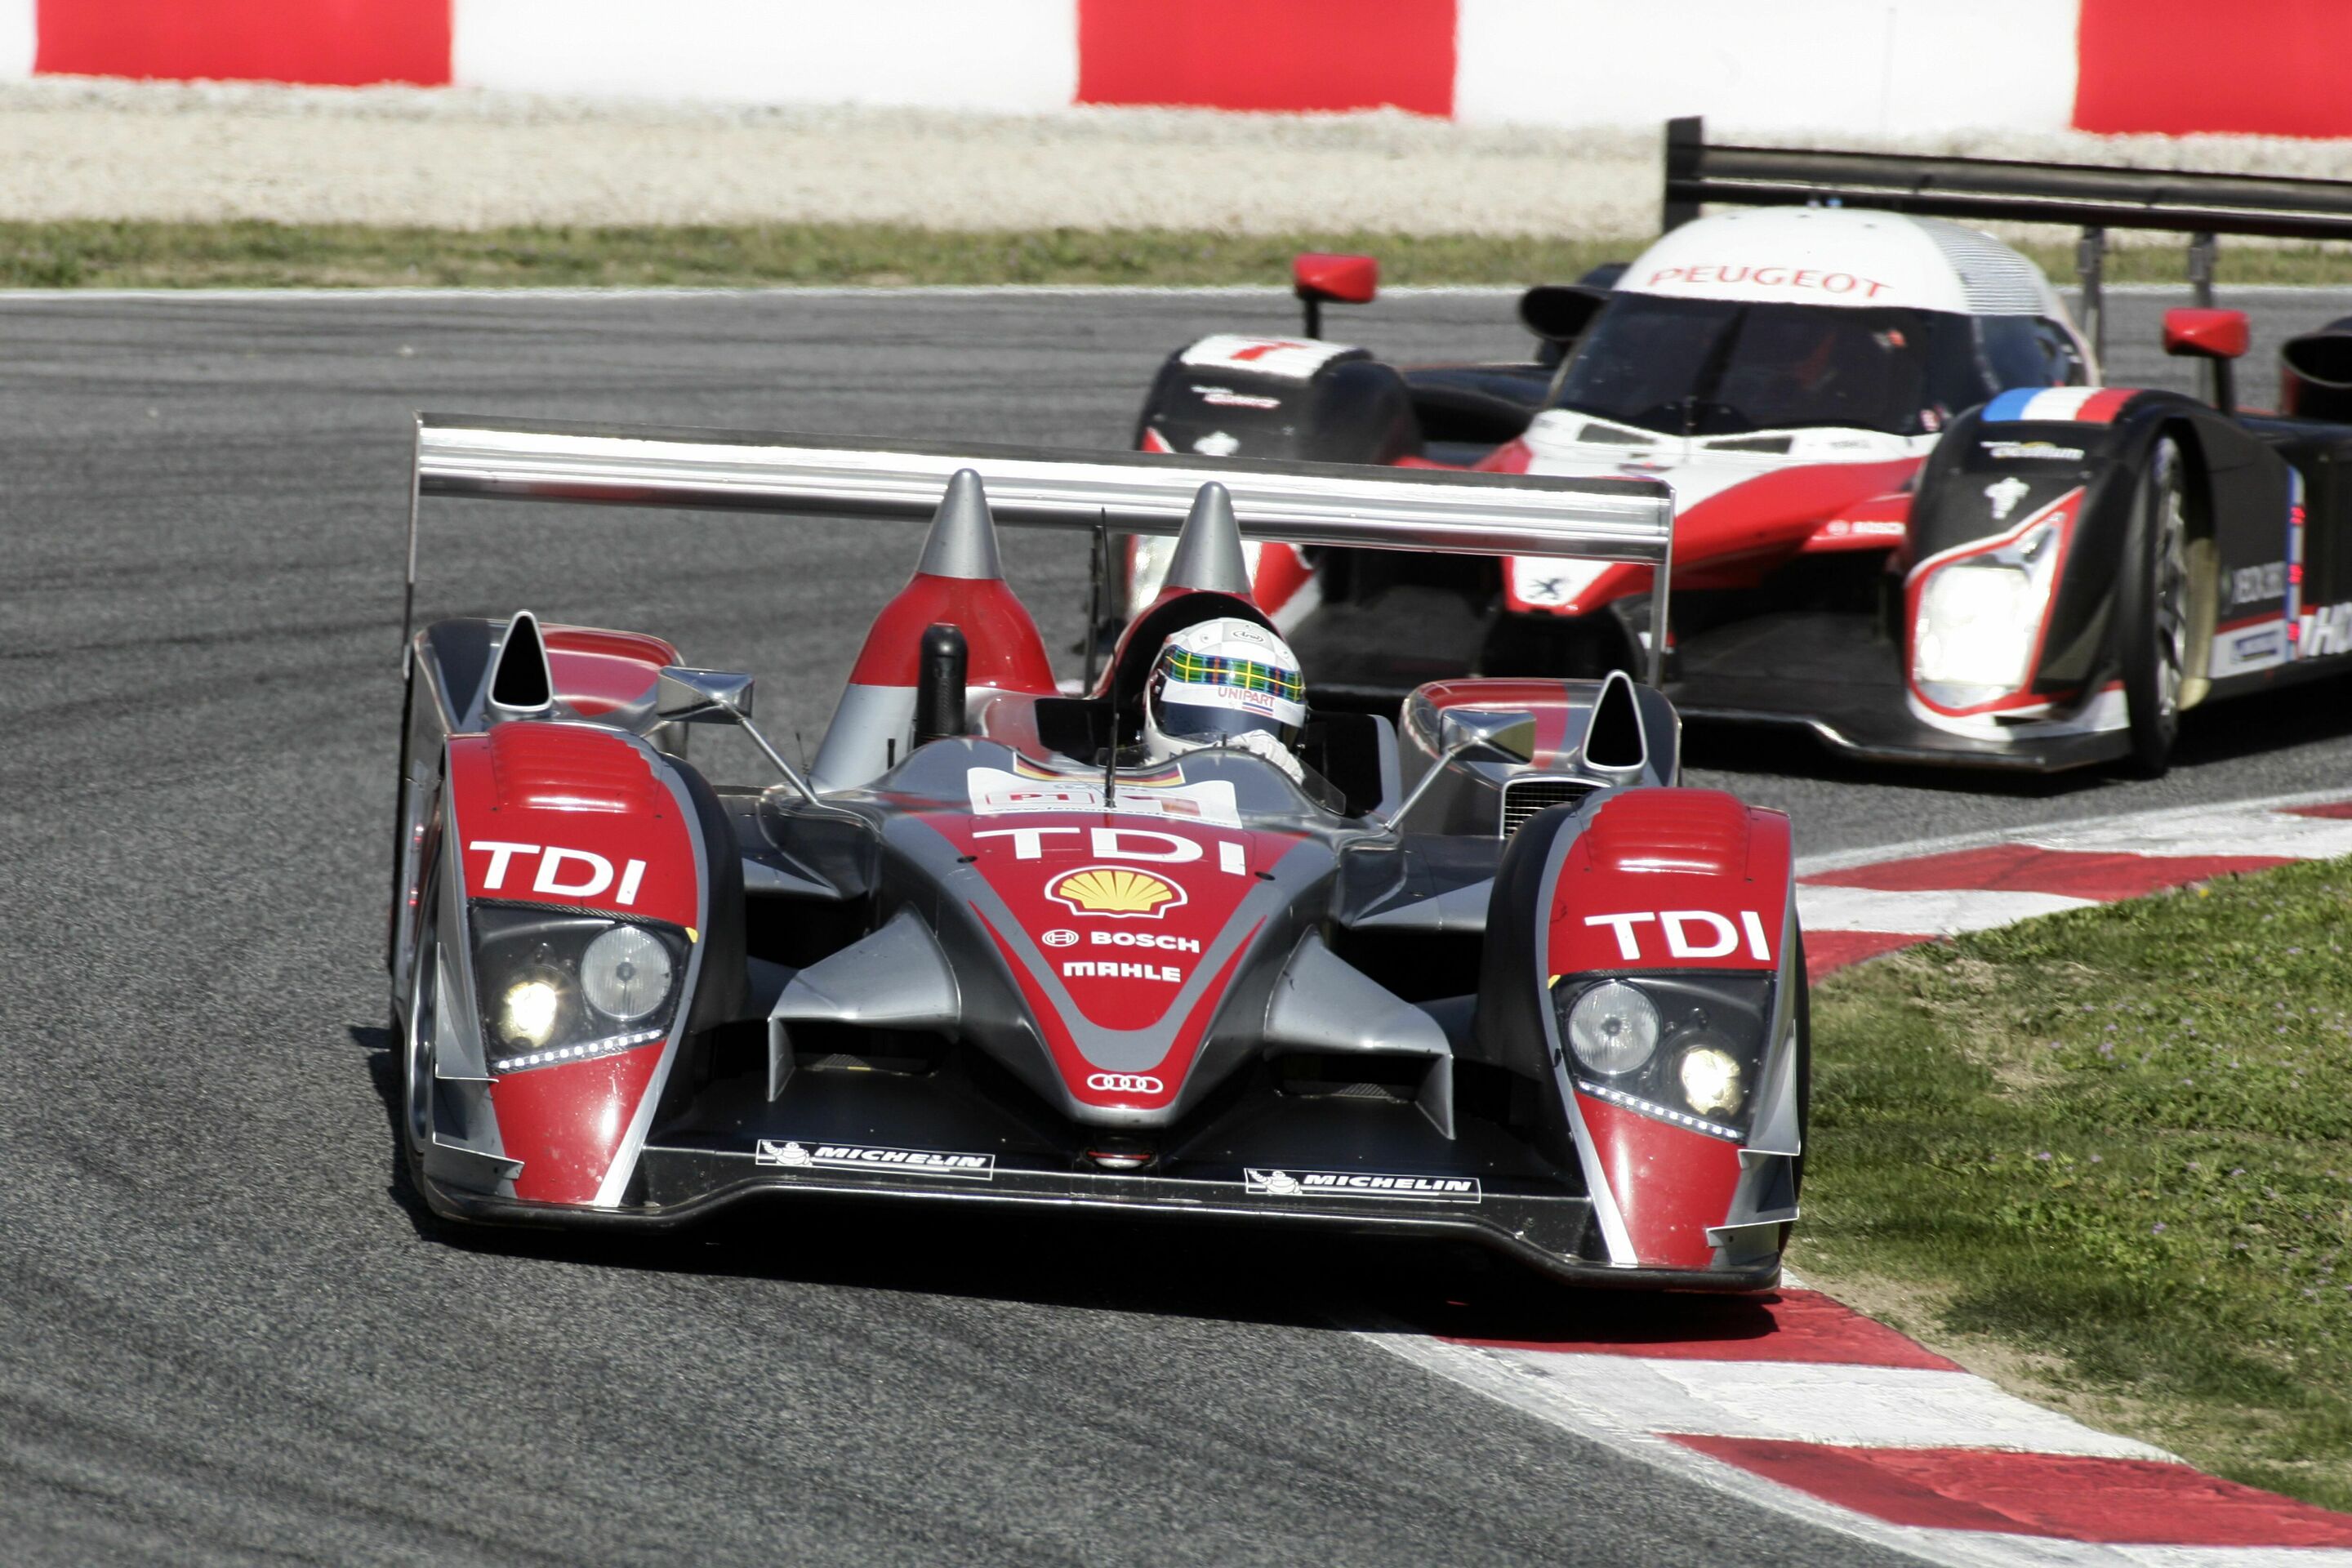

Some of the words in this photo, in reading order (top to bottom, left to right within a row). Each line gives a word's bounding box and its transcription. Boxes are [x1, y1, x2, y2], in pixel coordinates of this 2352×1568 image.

[1646, 265, 1892, 297] PEUGEOT
[1218, 687, 1276, 708] UNIPART
[1009, 793, 1070, 801] P1
[972, 826, 1246, 876] TDI
[469, 840, 647, 906] TDI
[1090, 931, 1200, 954] BOSCH
[1584, 911, 1771, 961] TDI
[1062, 961, 1182, 983] MAHLE
[814, 1146, 987, 1168] MICHELIN
[1303, 1174, 1472, 1192] MICHELIN
